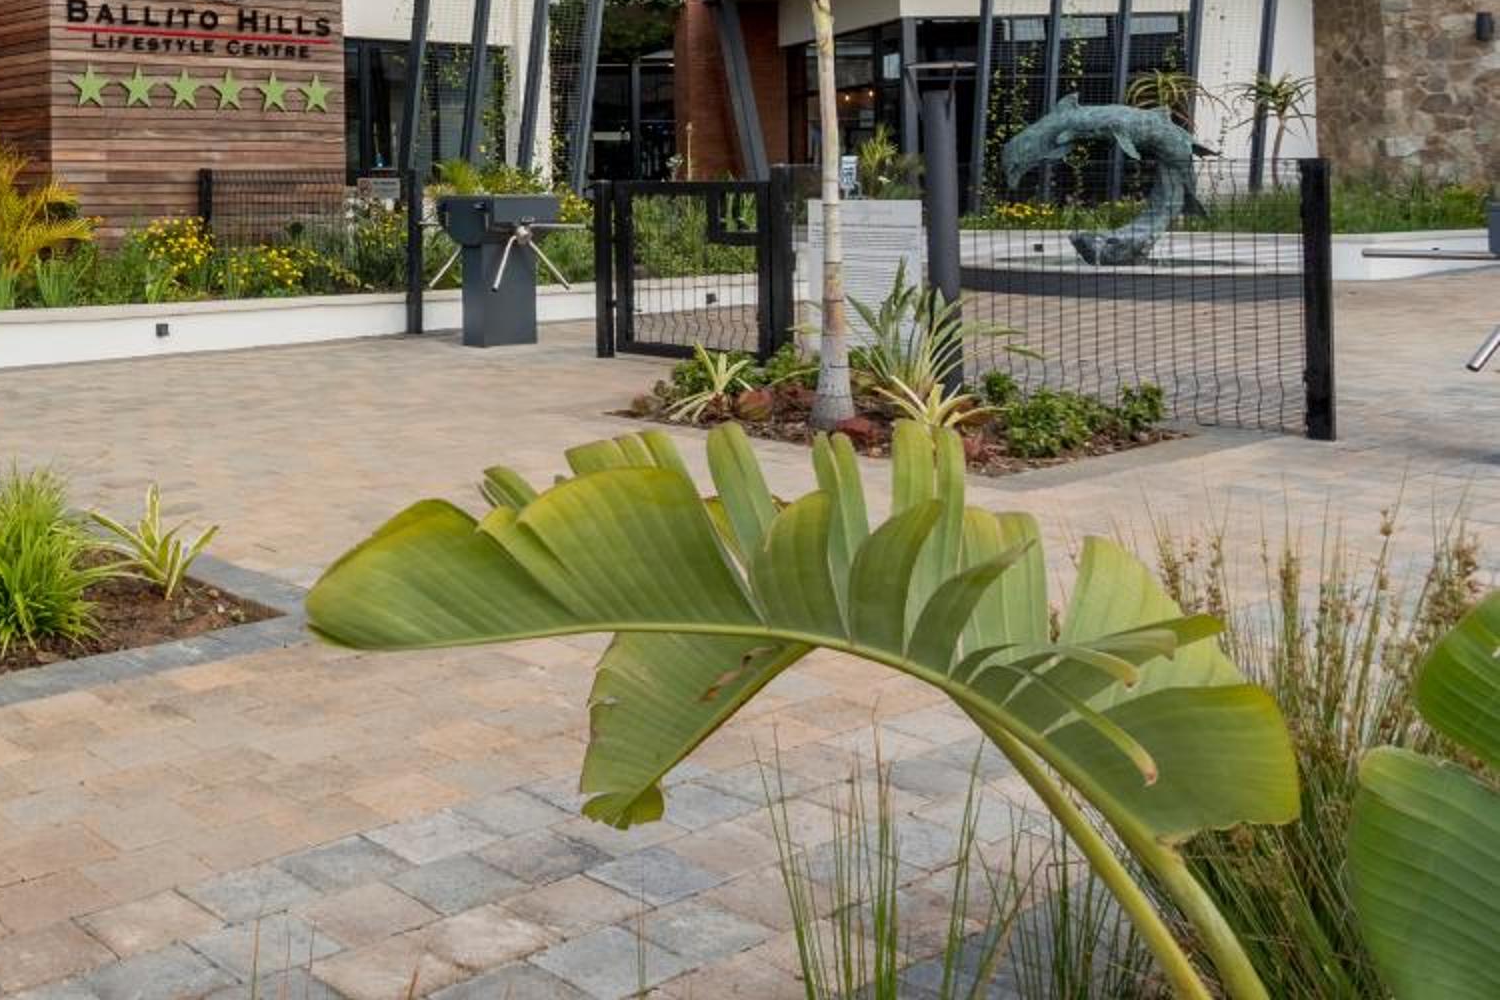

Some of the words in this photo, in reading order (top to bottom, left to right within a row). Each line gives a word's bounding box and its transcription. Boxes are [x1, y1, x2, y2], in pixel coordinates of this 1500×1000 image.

[238, 8, 330, 36] HILLS
[93, 33, 214, 53] LIFESTYLE
[227, 40, 309, 58] CENTRE
